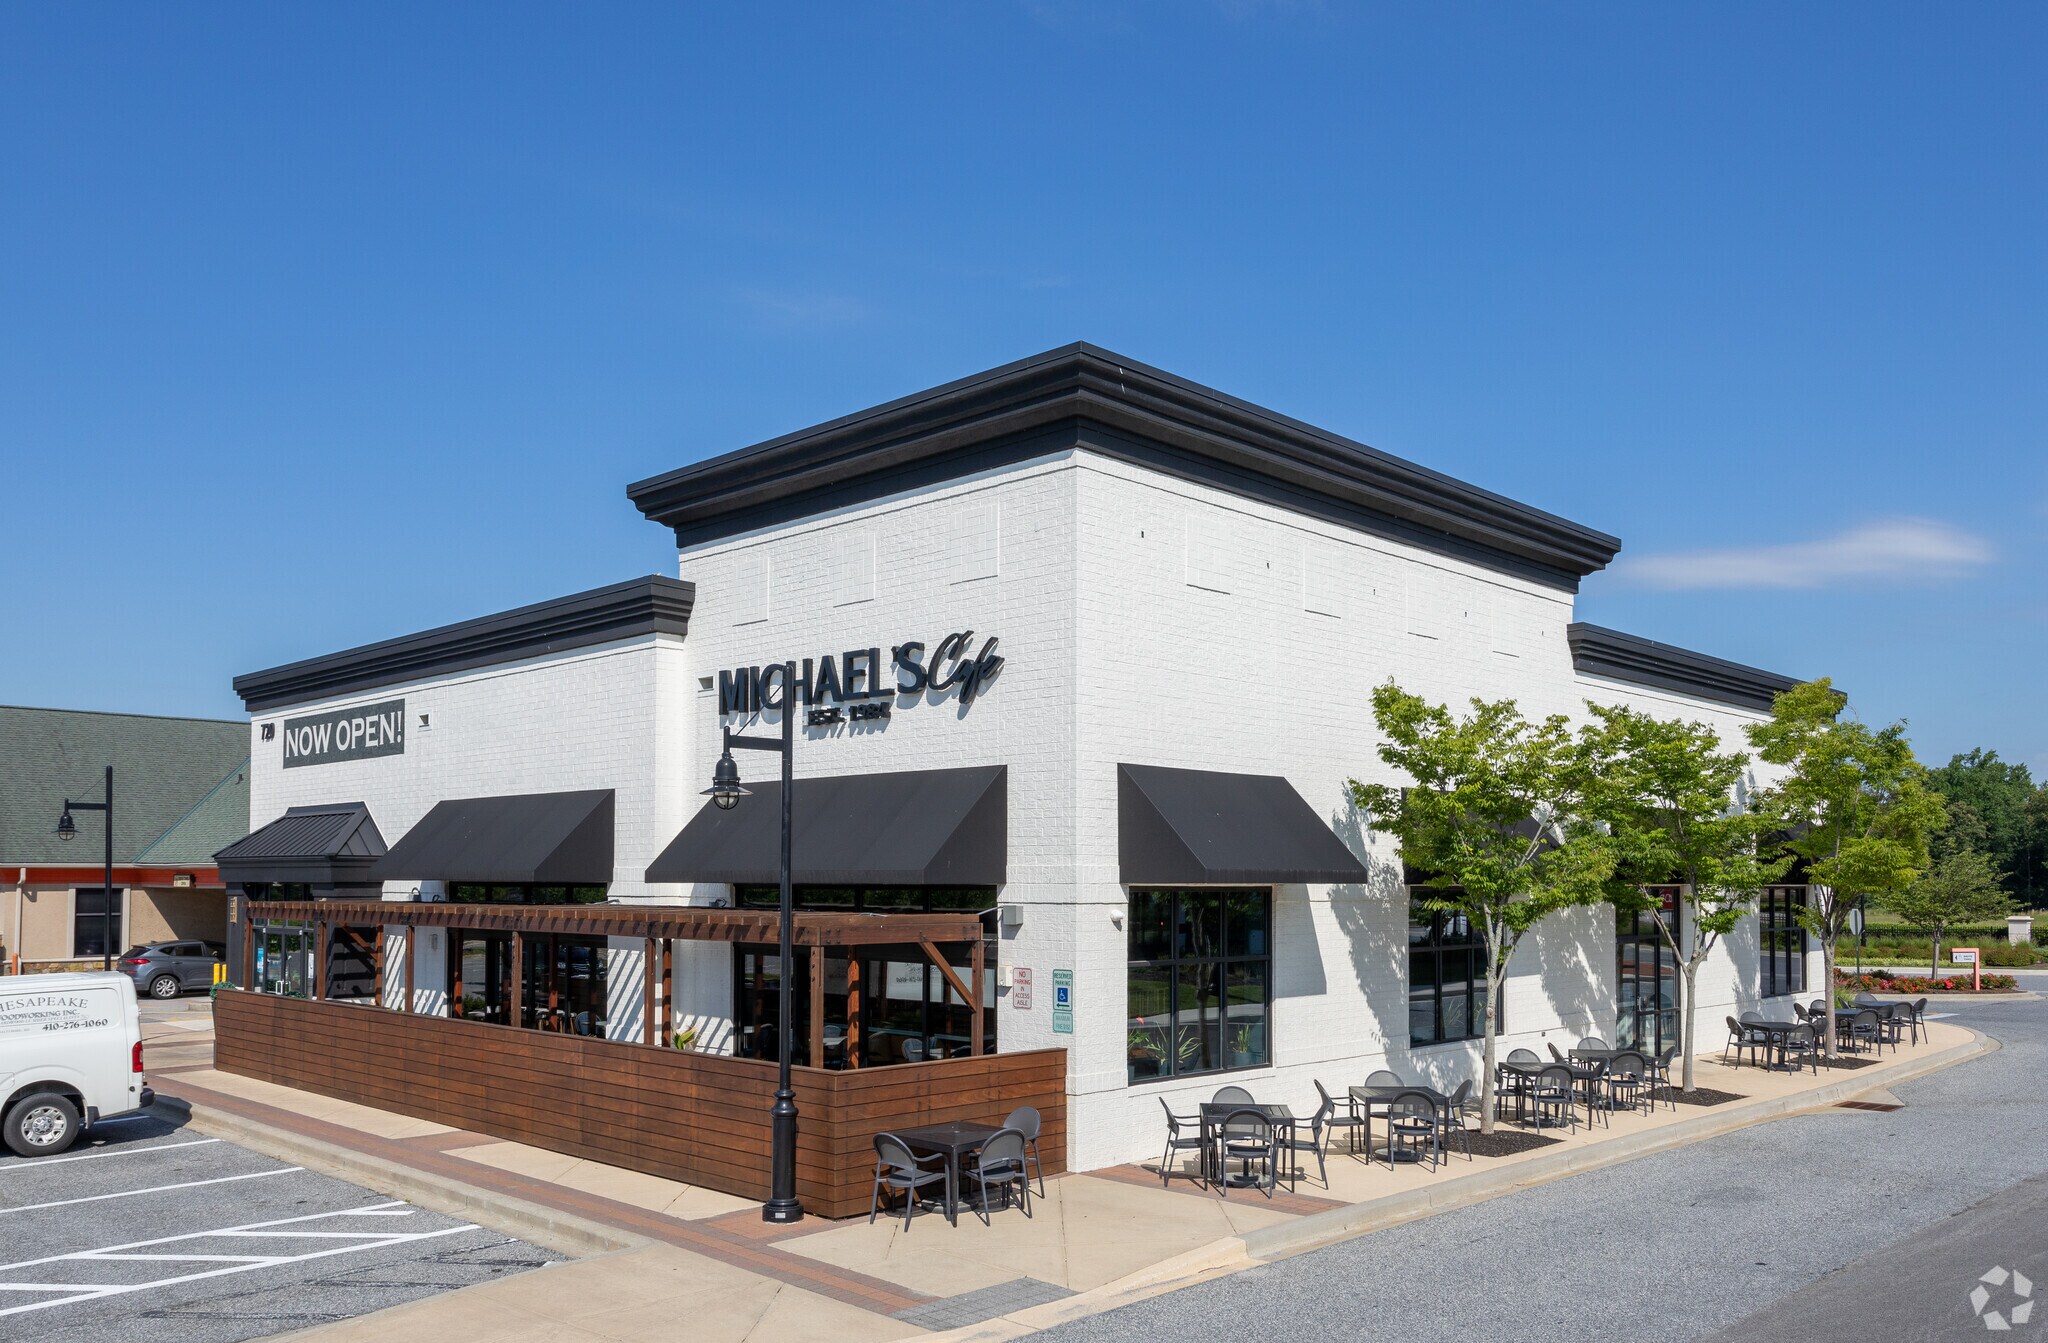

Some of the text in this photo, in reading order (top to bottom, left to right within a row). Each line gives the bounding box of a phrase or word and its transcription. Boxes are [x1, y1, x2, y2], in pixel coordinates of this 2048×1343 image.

[719, 641, 928, 715] MICHAEL'S
[285, 710, 403, 758] NOW OPEN!
[1053, 972, 1072, 980] RESERVED
[1015, 992, 1030, 1000] ACCESS
[0, 1010, 61, 1021] OODWORKING
[42, 1018, 109, 1031] 410-276-1060
